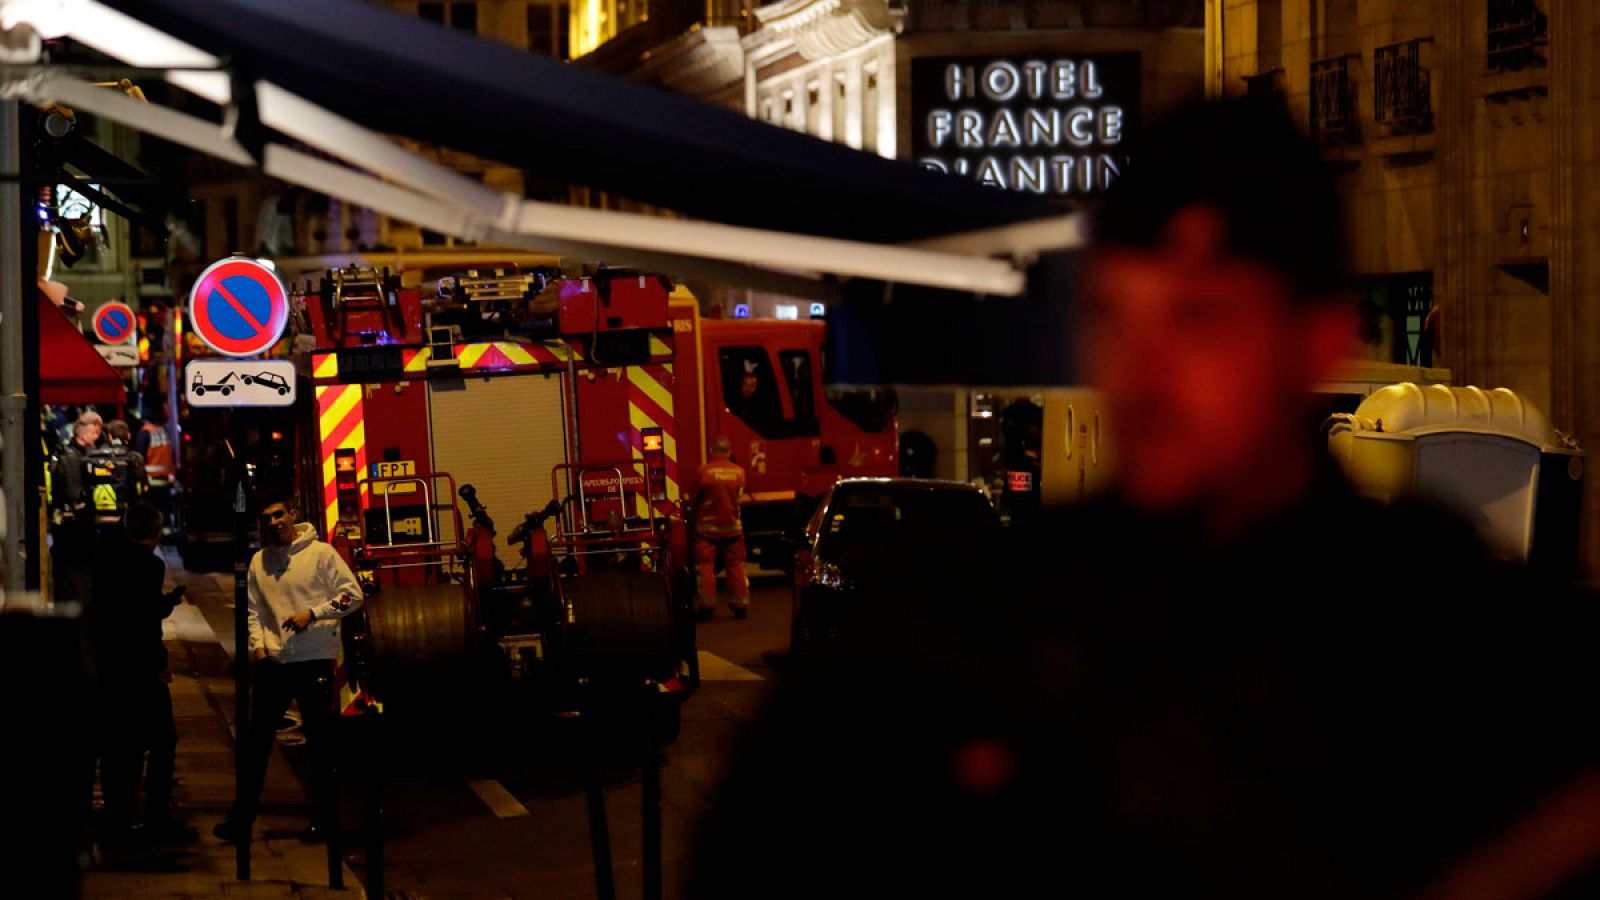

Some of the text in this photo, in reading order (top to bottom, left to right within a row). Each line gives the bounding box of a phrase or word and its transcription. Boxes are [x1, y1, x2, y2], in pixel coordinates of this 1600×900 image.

[945, 59, 1103, 101] HOTEL
[927, 105, 1124, 148] FRANCE
[380, 463, 408, 477] FPT
